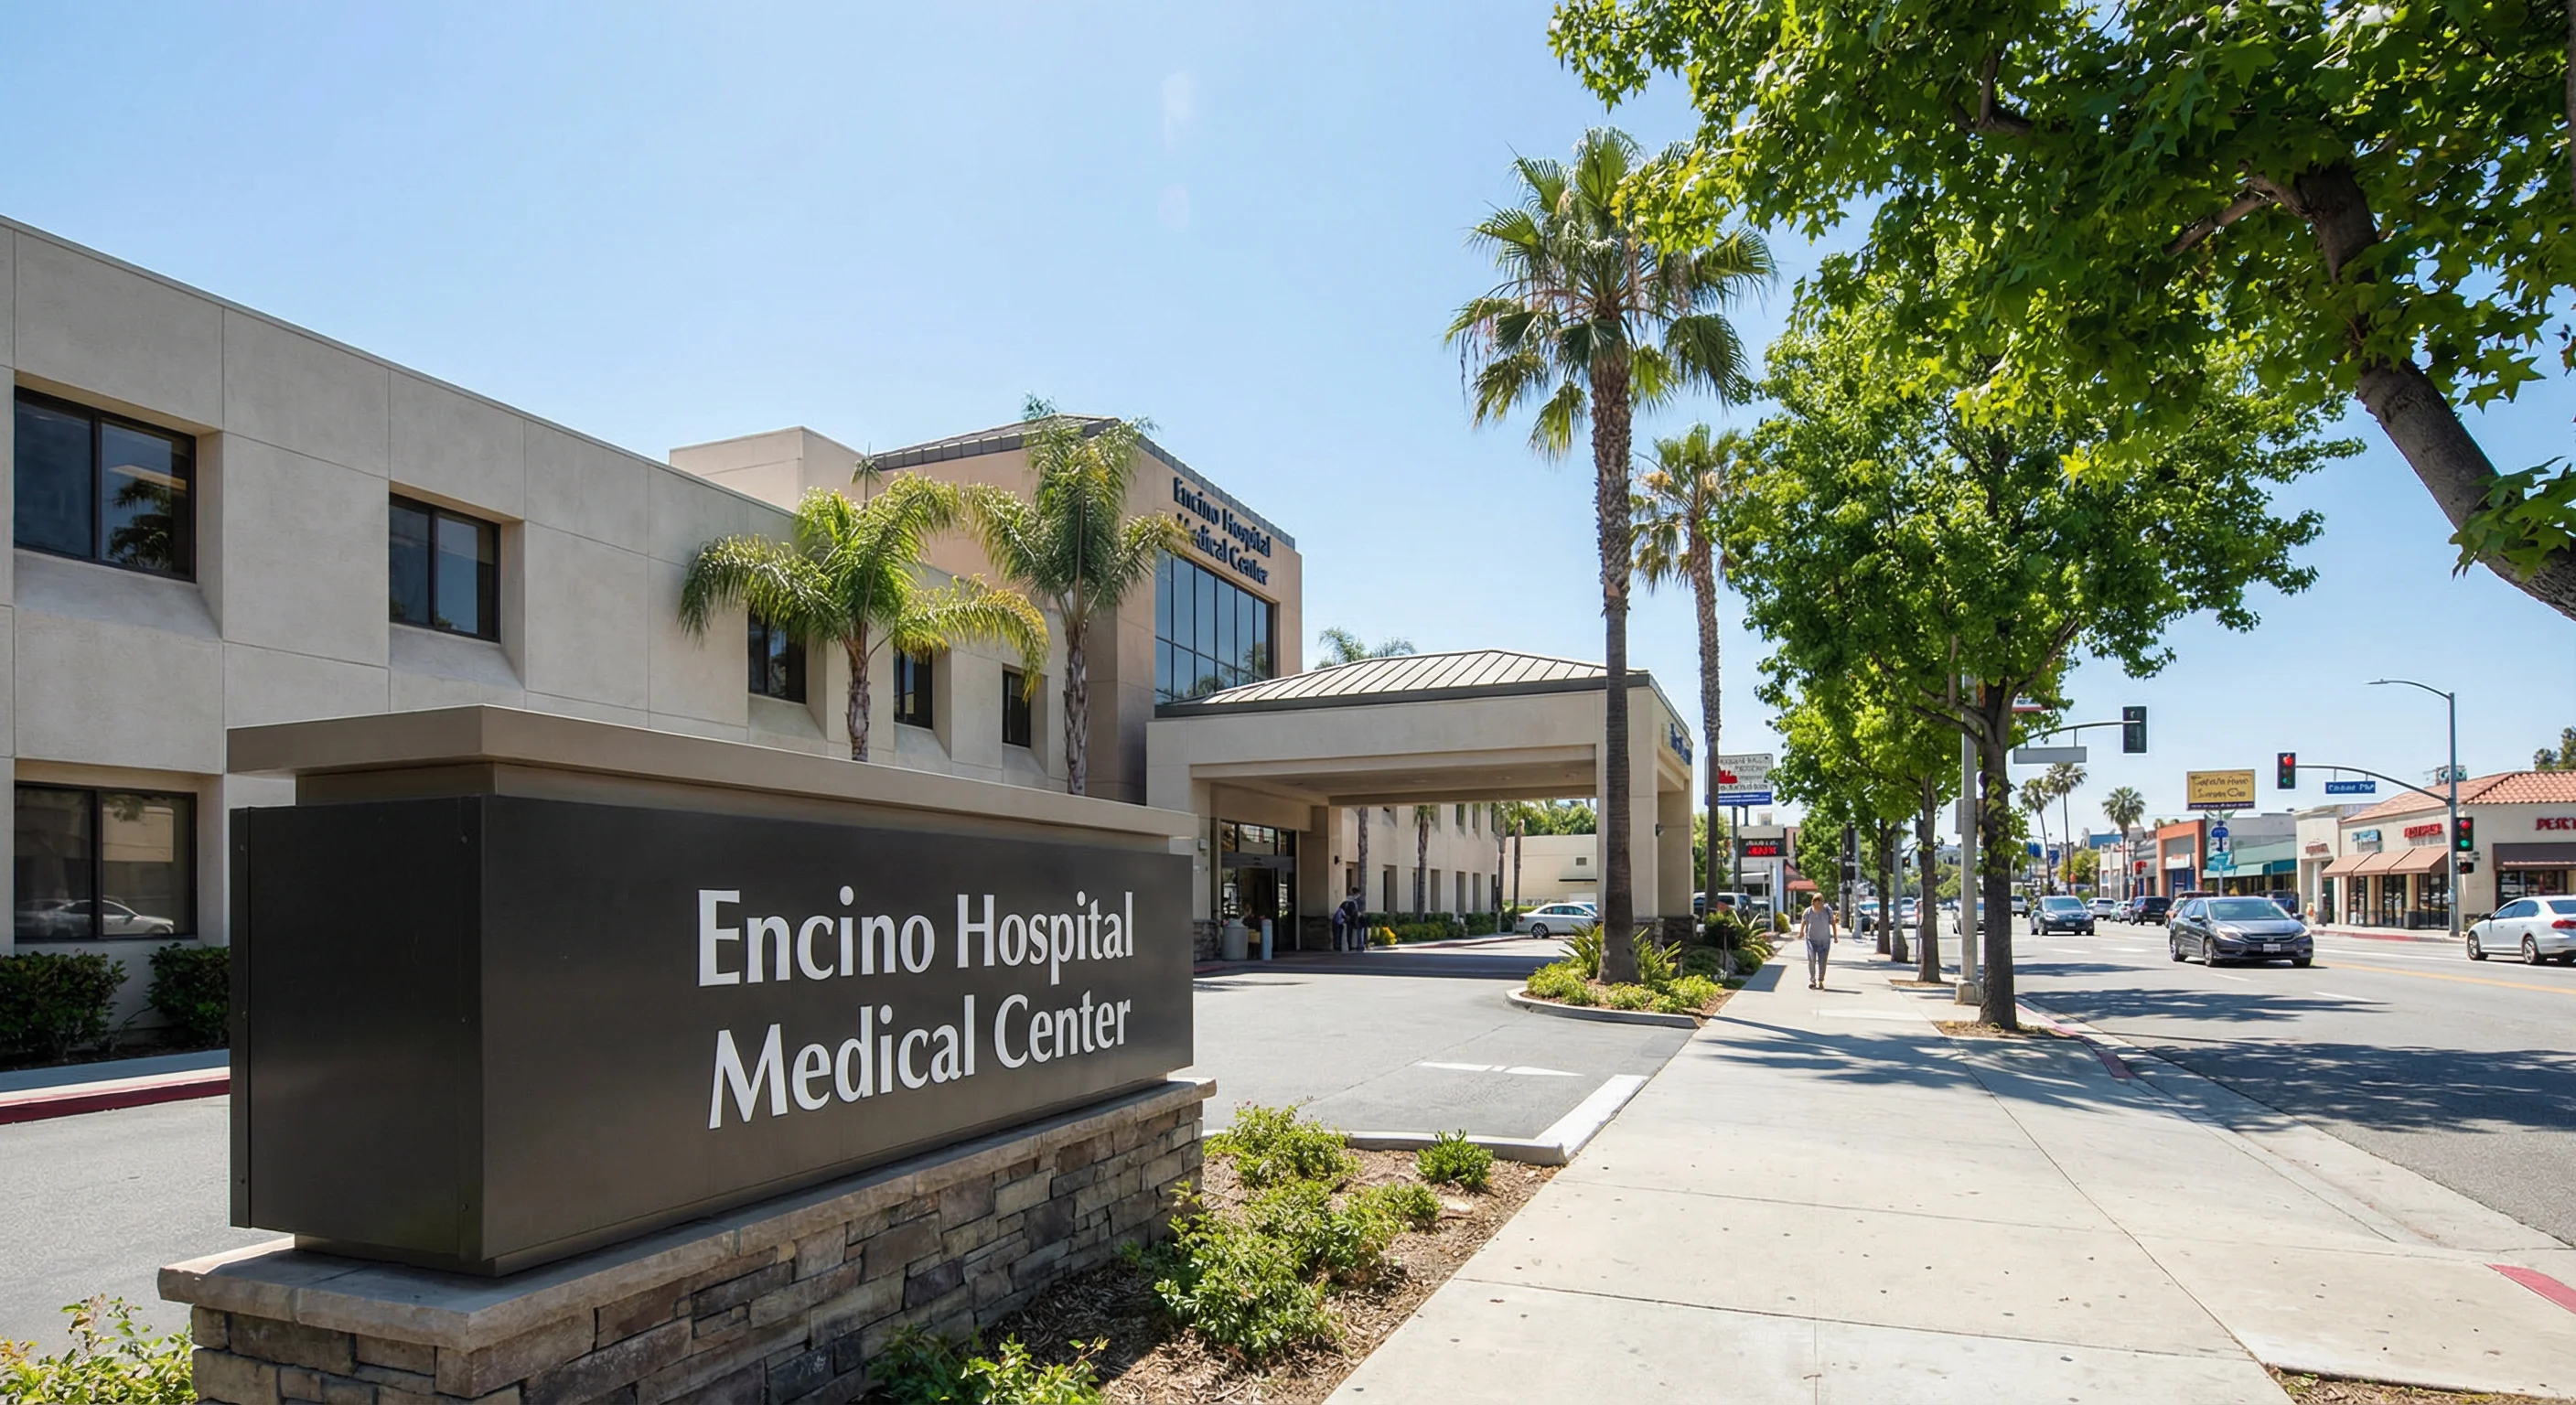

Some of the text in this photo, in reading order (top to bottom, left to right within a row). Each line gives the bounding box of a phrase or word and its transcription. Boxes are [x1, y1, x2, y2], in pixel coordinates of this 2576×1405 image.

[1174, 477, 1271, 558] Encino Hospital
[698, 885, 1133, 987] Encino Hospital
[708, 990, 1131, 1131] Medical Center
